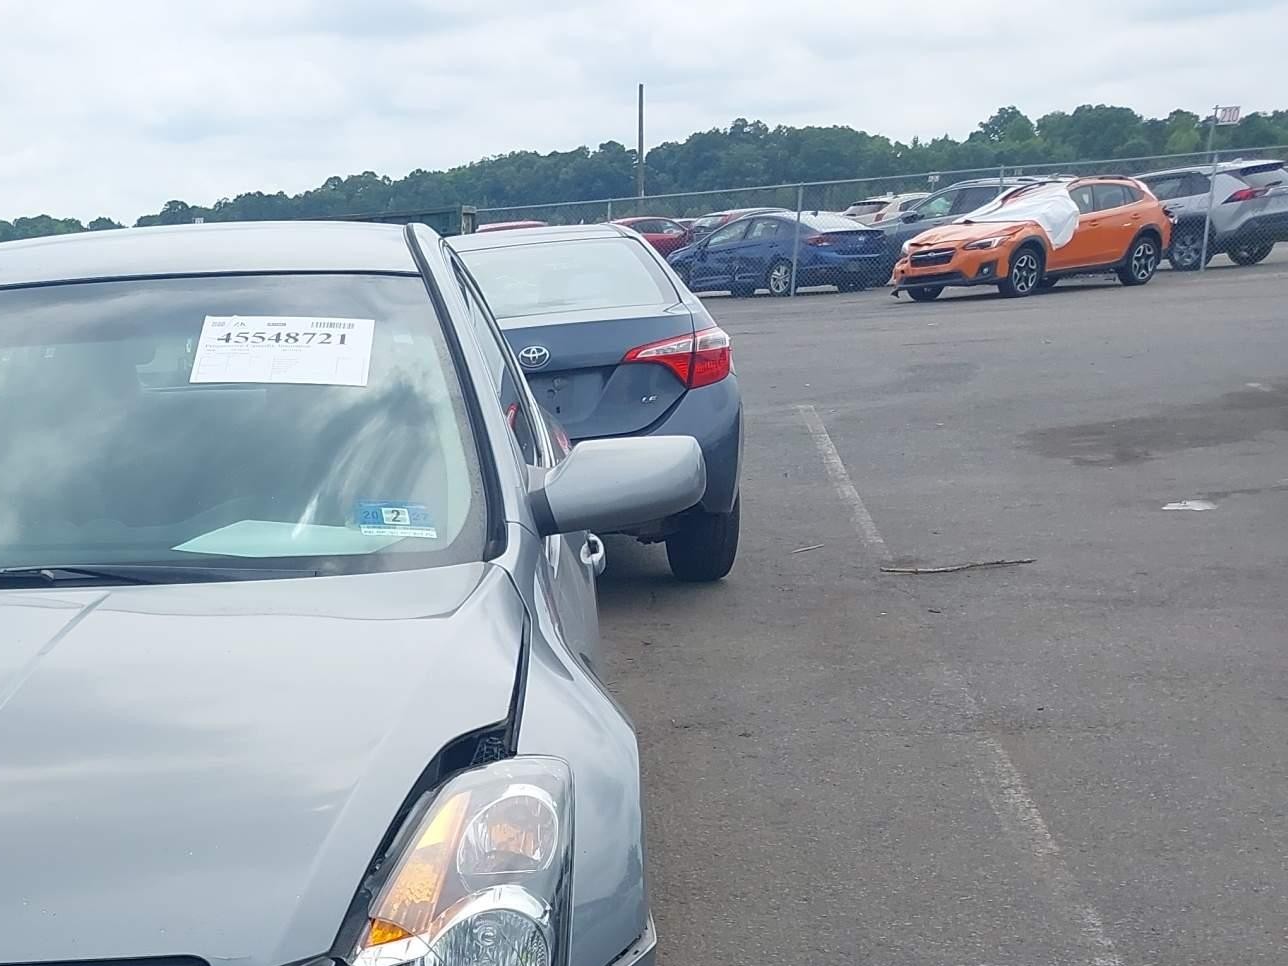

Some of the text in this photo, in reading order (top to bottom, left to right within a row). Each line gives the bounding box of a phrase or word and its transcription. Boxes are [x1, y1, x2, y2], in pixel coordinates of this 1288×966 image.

[1221, 108, 1240, 122] 210
[217, 331, 347, 345] 45548721
[363, 510, 379, 520] 20
[391, 509, 401, 522] 2
